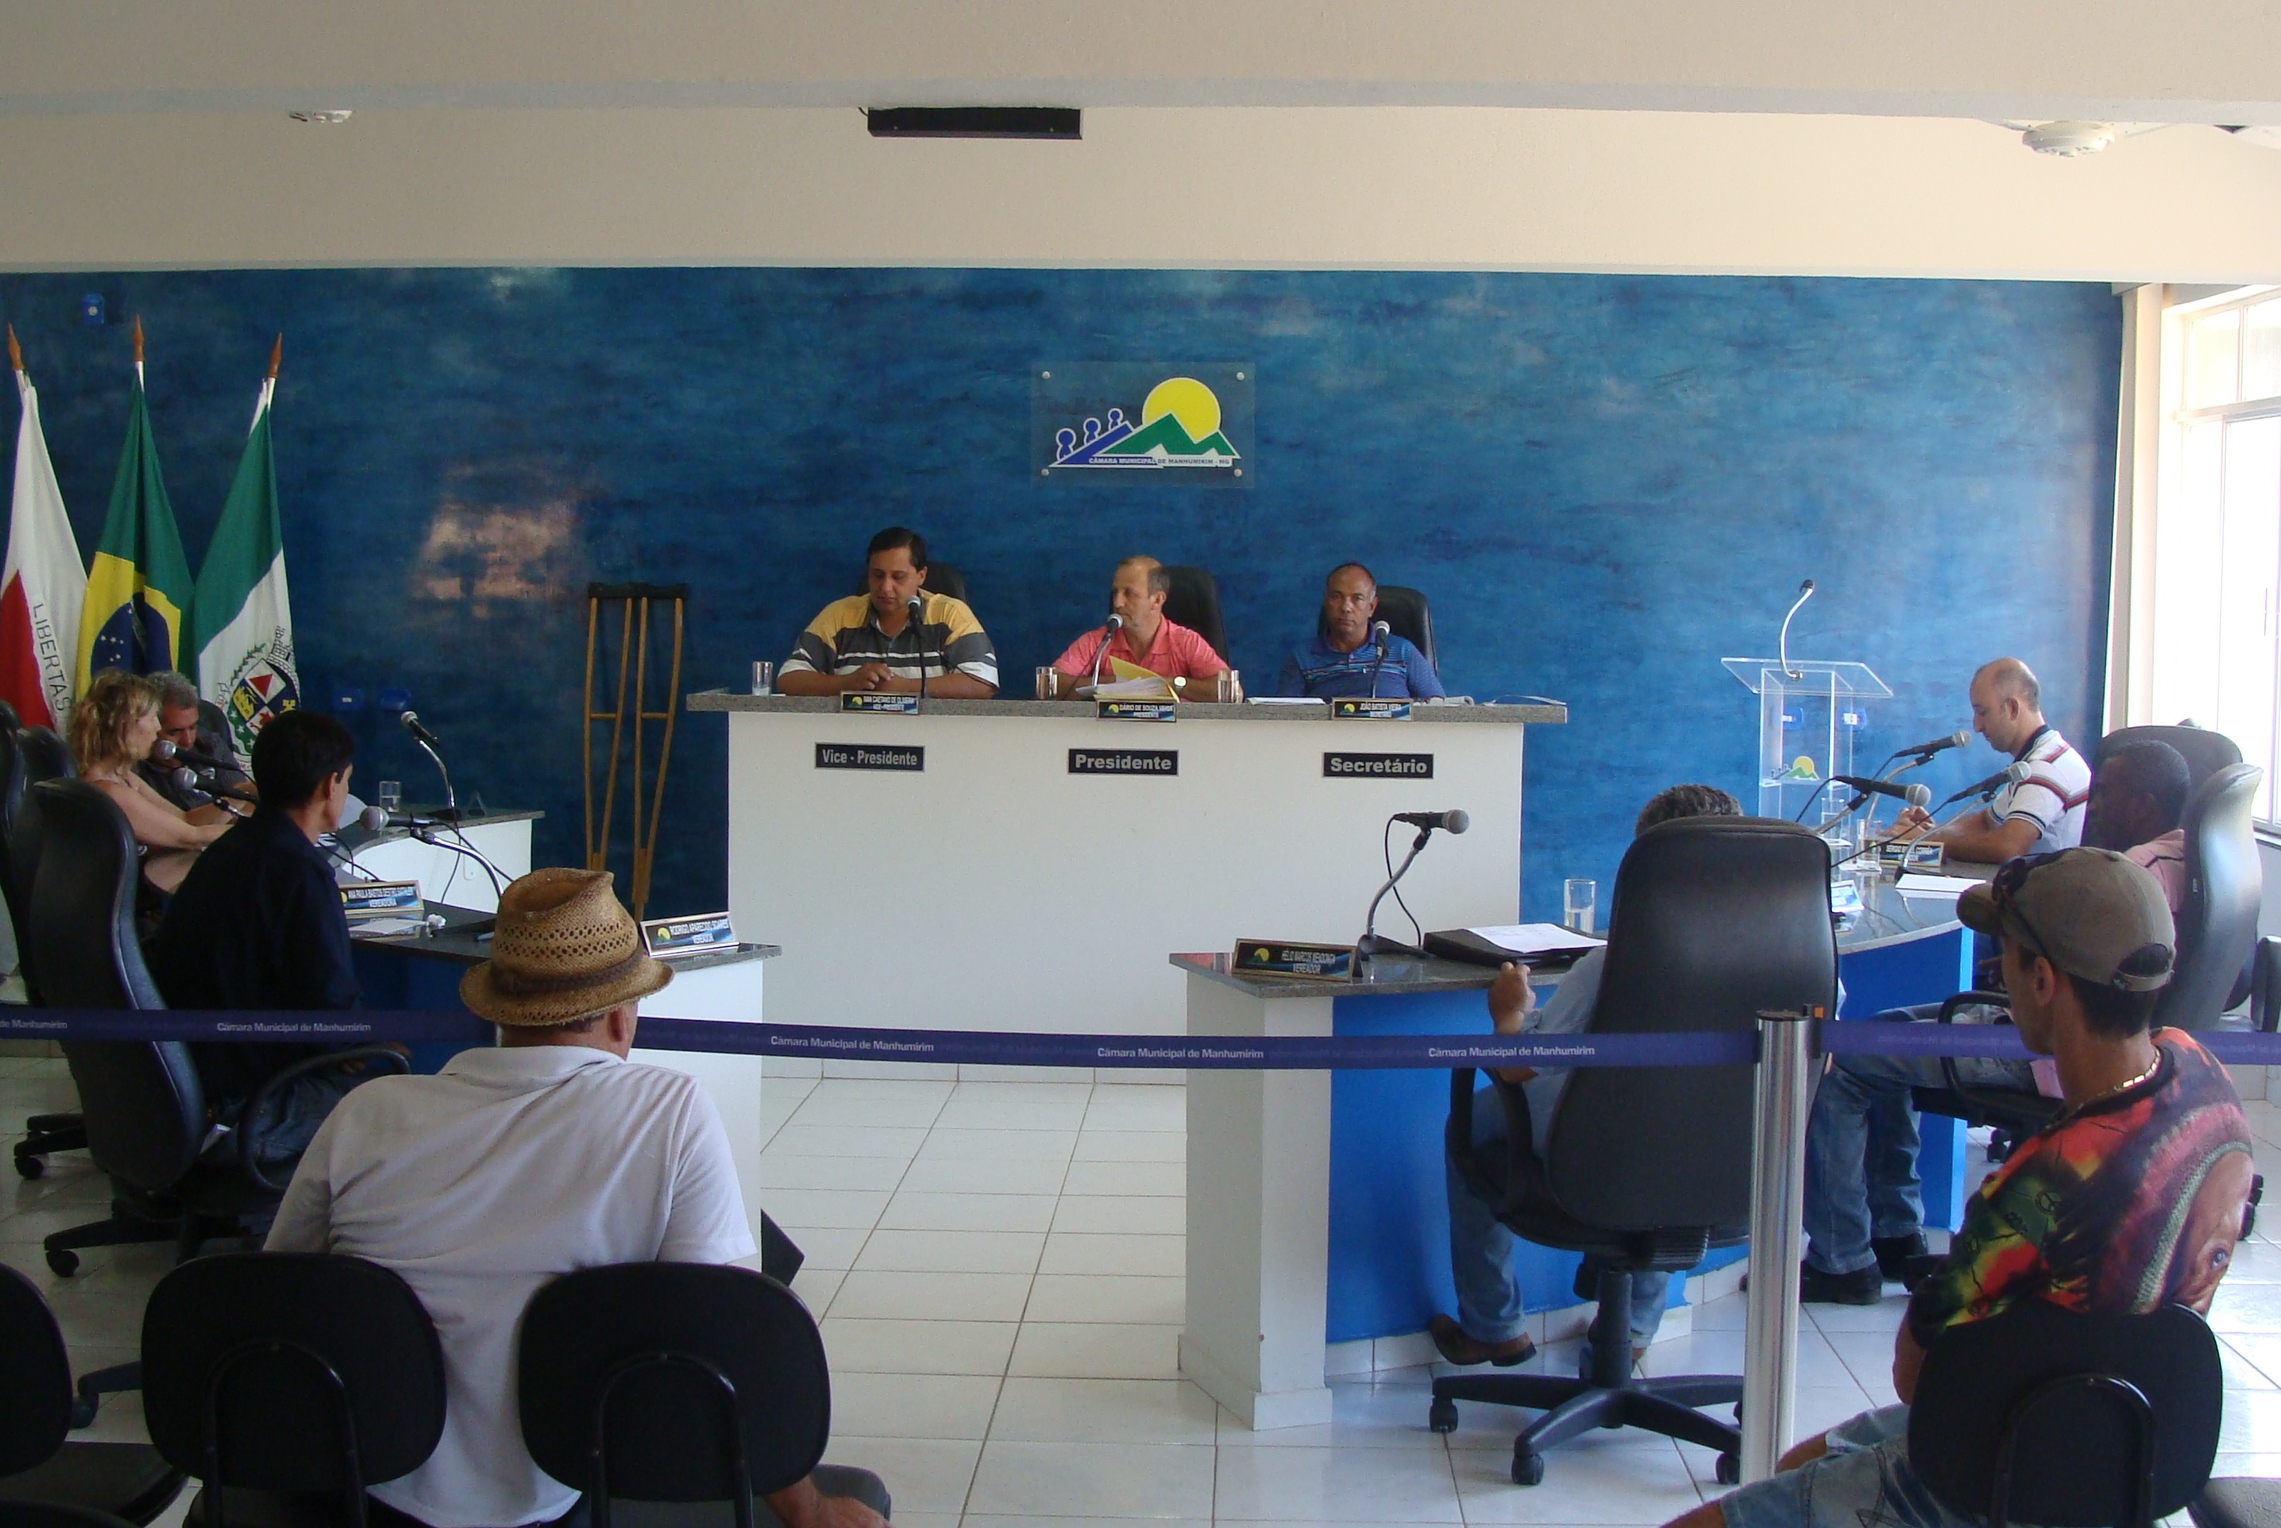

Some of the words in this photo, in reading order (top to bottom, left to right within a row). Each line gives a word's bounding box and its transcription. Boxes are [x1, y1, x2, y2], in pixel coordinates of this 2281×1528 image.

[33, 603, 73, 711] LIBERTAS
[822, 749, 848, 764] Vice
[857, 750, 918, 766] Presidente
[1075, 754, 1172, 770] Presidente
[1330, 757, 1427, 774] Secretário
[12, 1019, 68, 1029] Manhumirim
[217, 1021, 253, 1032] Câmara
[254, 1022, 299, 1034] Municipal
[300, 1022, 312, 1032] de
[313, 1022, 371, 1033] Manhumirim
[770, 1035, 808, 1047] Câmara
[810, 1037, 858, 1050] Municipal
[859, 1039, 871, 1049] de
[873, 1040, 935, 1051] Manhumirim
[1097, 1047, 1136, 1058] Câmara
[1138, 1048, 1186, 1060] Municipal
[1187, 1048, 1200, 1058] de
[1202, 1049, 1264, 1059] Manhumirim
[1428, 1047, 1467, 1057] Câmara
[1469, 1046, 1517, 1058] Municipal
[1519, 1046, 1531, 1056] de
[1533, 1045, 1596, 1056] Manhumirim
